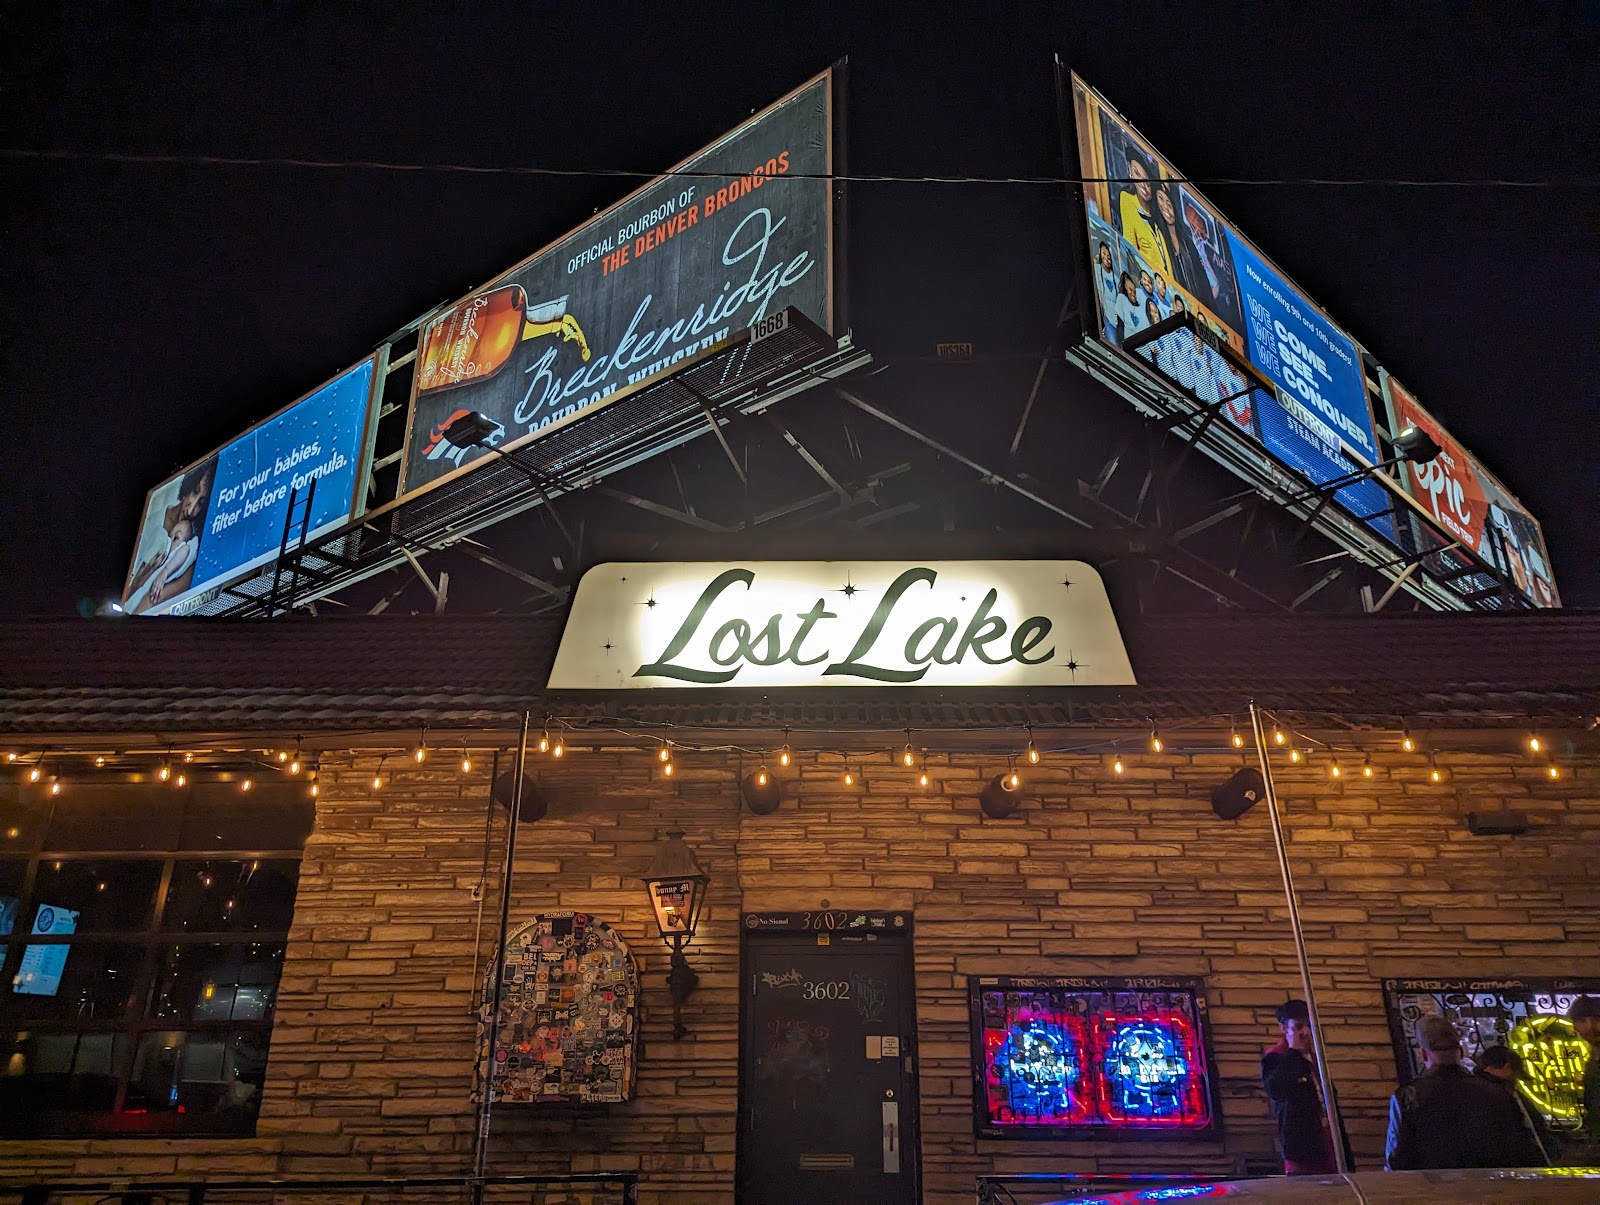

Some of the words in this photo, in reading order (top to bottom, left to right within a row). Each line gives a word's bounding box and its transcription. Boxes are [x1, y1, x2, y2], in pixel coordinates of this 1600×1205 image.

[567, 239, 615, 274] OFFICIAL
[617, 201, 675, 246] BOURBON
[678, 185, 697, 208] OF
[602, 244, 630, 277] THE
[635, 204, 699, 259] DENVER
[704, 150, 791, 218] BRONCOS
[514, 207, 814, 424] Breckenridge
[753, 311, 784, 340] 1668
[1246, 264, 1262, 285] Now
[1262, 277, 1291, 313] enrolling
[1291, 306, 1302, 321] 9th
[1303, 315, 1315, 332] and
[1315, 325, 1329, 346] 10th
[1246, 293, 1273, 331] WE
[1274, 319, 1333, 383] COME.
[1250, 316, 1277, 354] WE
[1278, 341, 1320, 391] SEE.
[1255, 340, 1282, 378] WE
[1282, 368, 1374, 454] CONQUER.
[1281, 392, 1336, 447] OUTFRONT
[210, 508, 242, 536] filter
[243, 485, 288, 518] before
[290, 452, 348, 493] formula.
[217, 486, 240, 508] For
[239, 466, 272, 500] your
[273, 440, 322, 475] babies,
[174, 587, 218, 614] OUTFRONT
[631, 567, 838, 685] Lost
[821, 566, 1057, 684] Lake
[802, 911, 848, 930] 3602
[802, 981, 850, 1000] 3602
